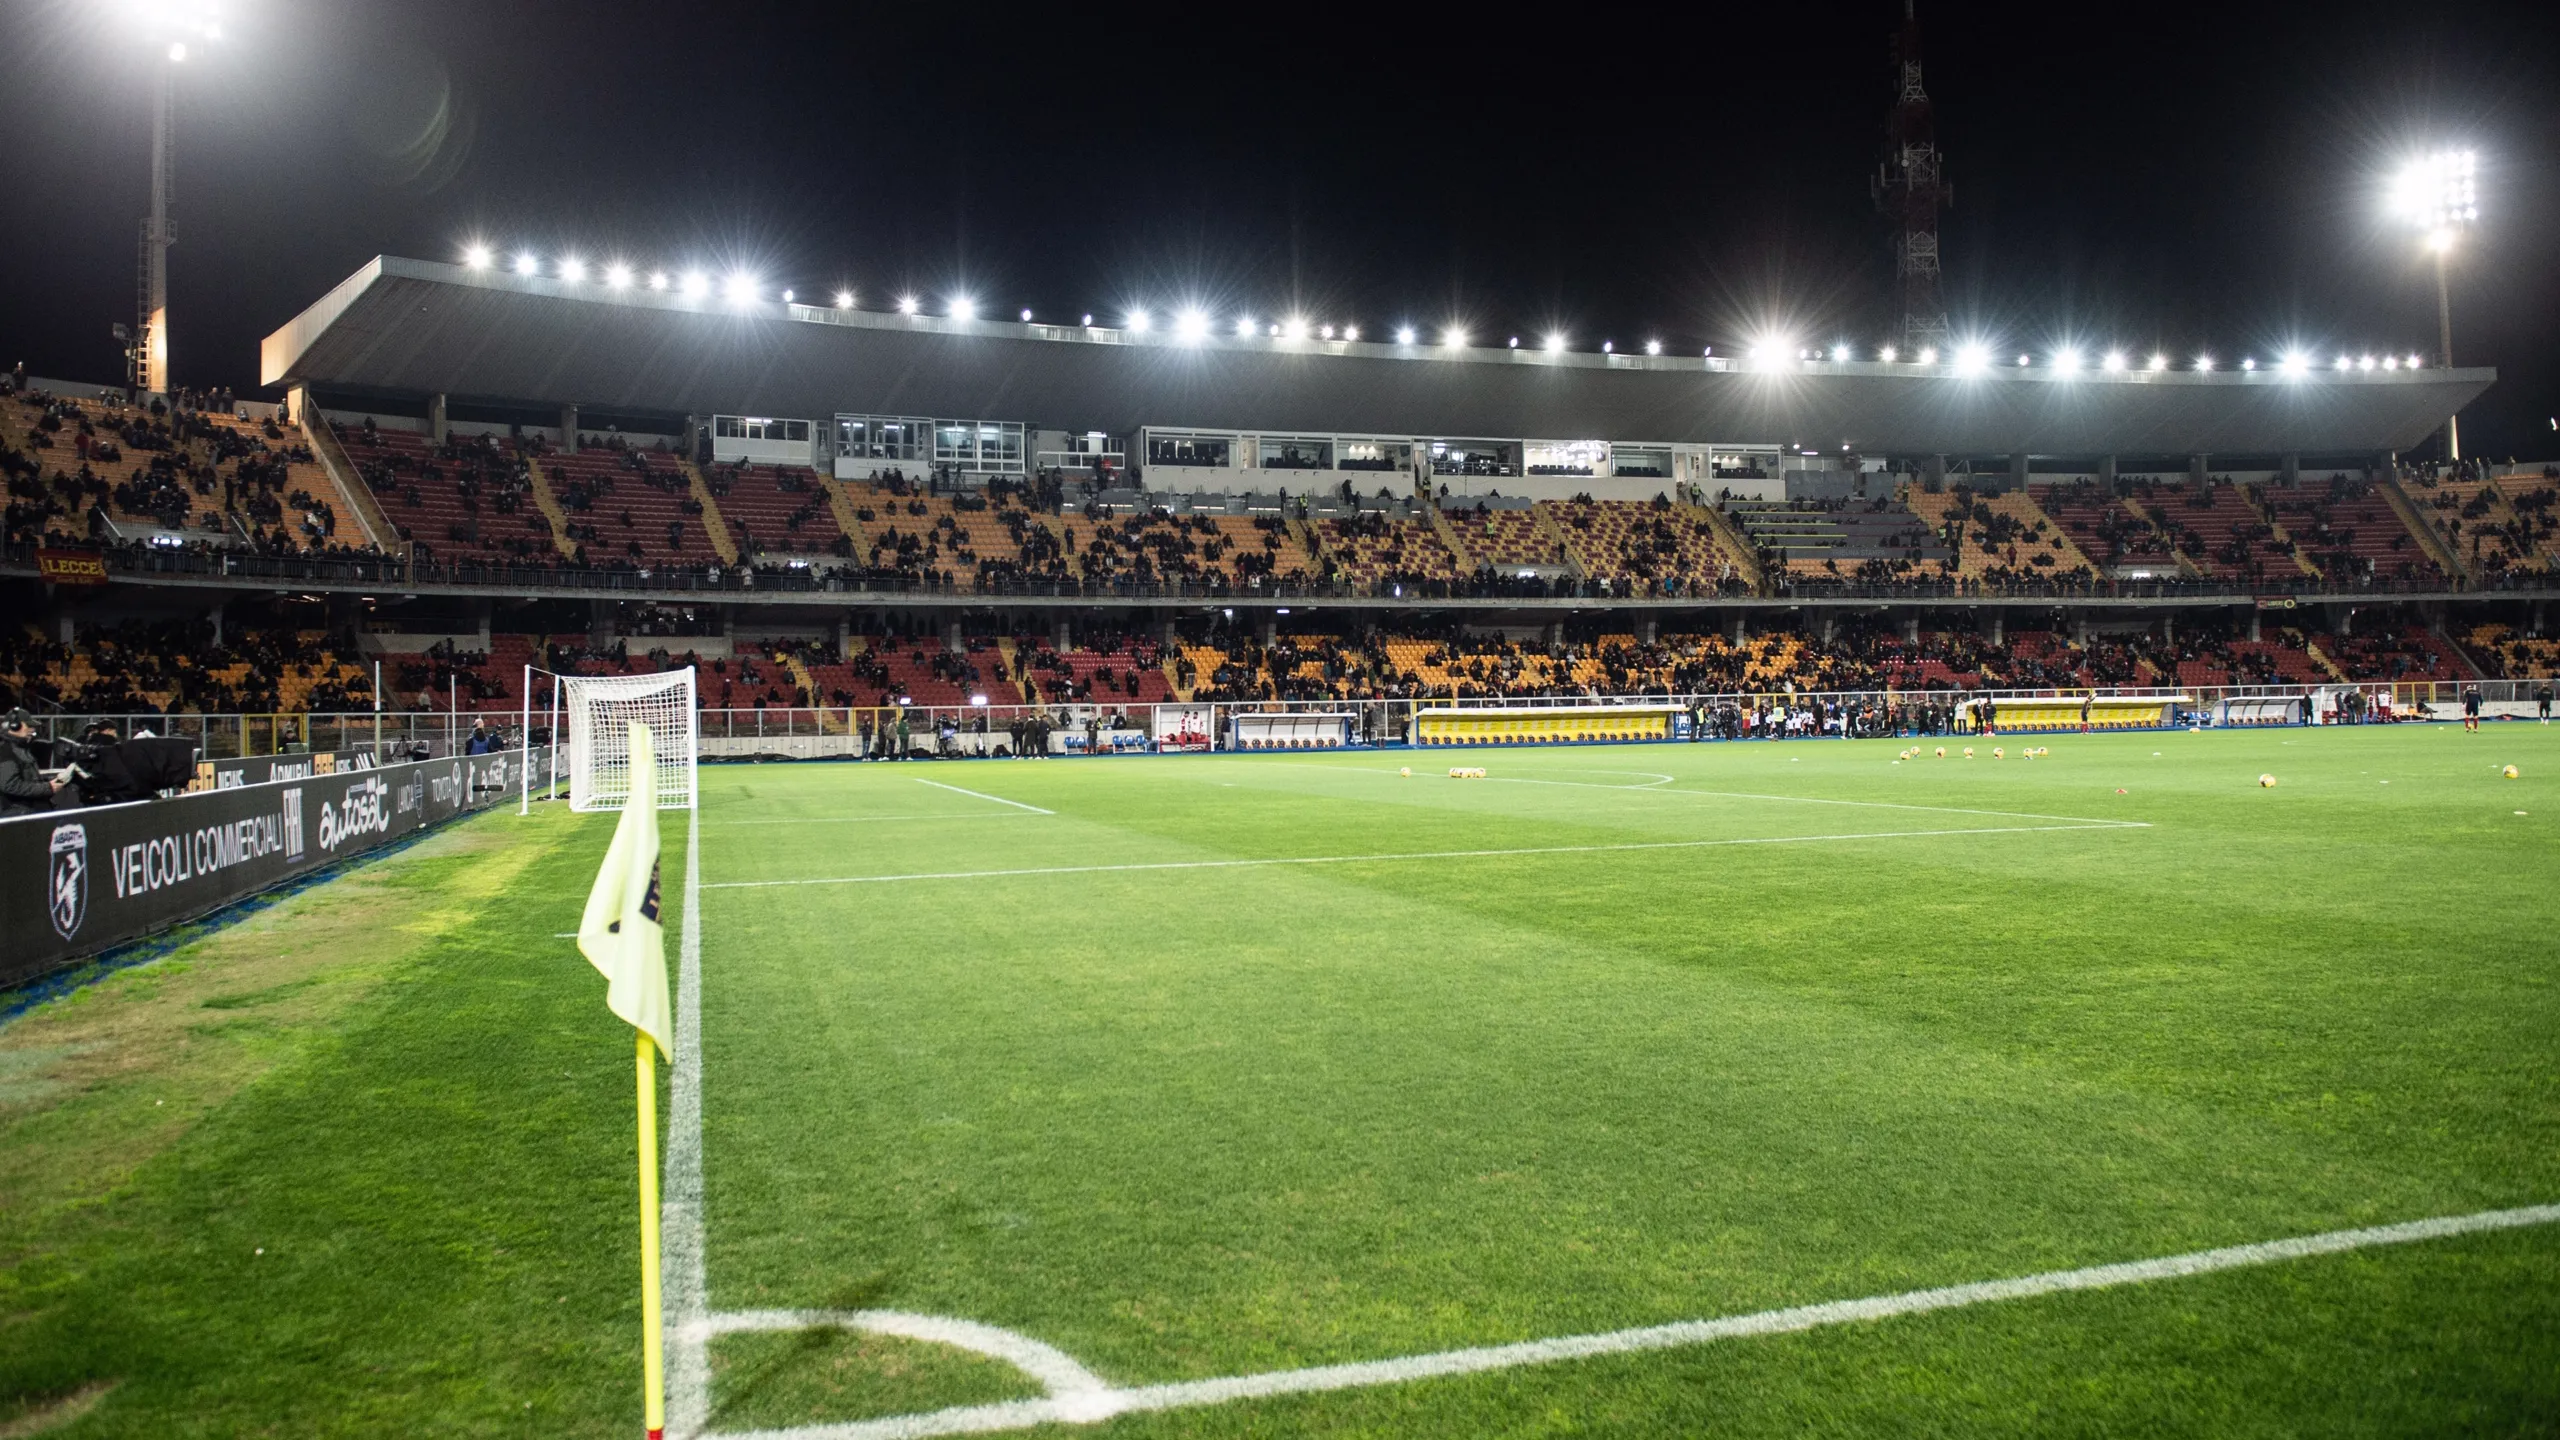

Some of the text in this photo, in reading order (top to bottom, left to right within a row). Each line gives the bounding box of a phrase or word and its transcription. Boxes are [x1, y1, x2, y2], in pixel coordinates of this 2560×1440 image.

[48, 559, 99, 575] LECCE
[319, 774, 390, 852] autosat
[397, 784, 414, 813] LANCIA
[432, 776, 451, 802] TOYOTA
[283, 787, 303, 857] FIAT
[112, 812, 283, 898] VEICOLI COMMERCIALI
